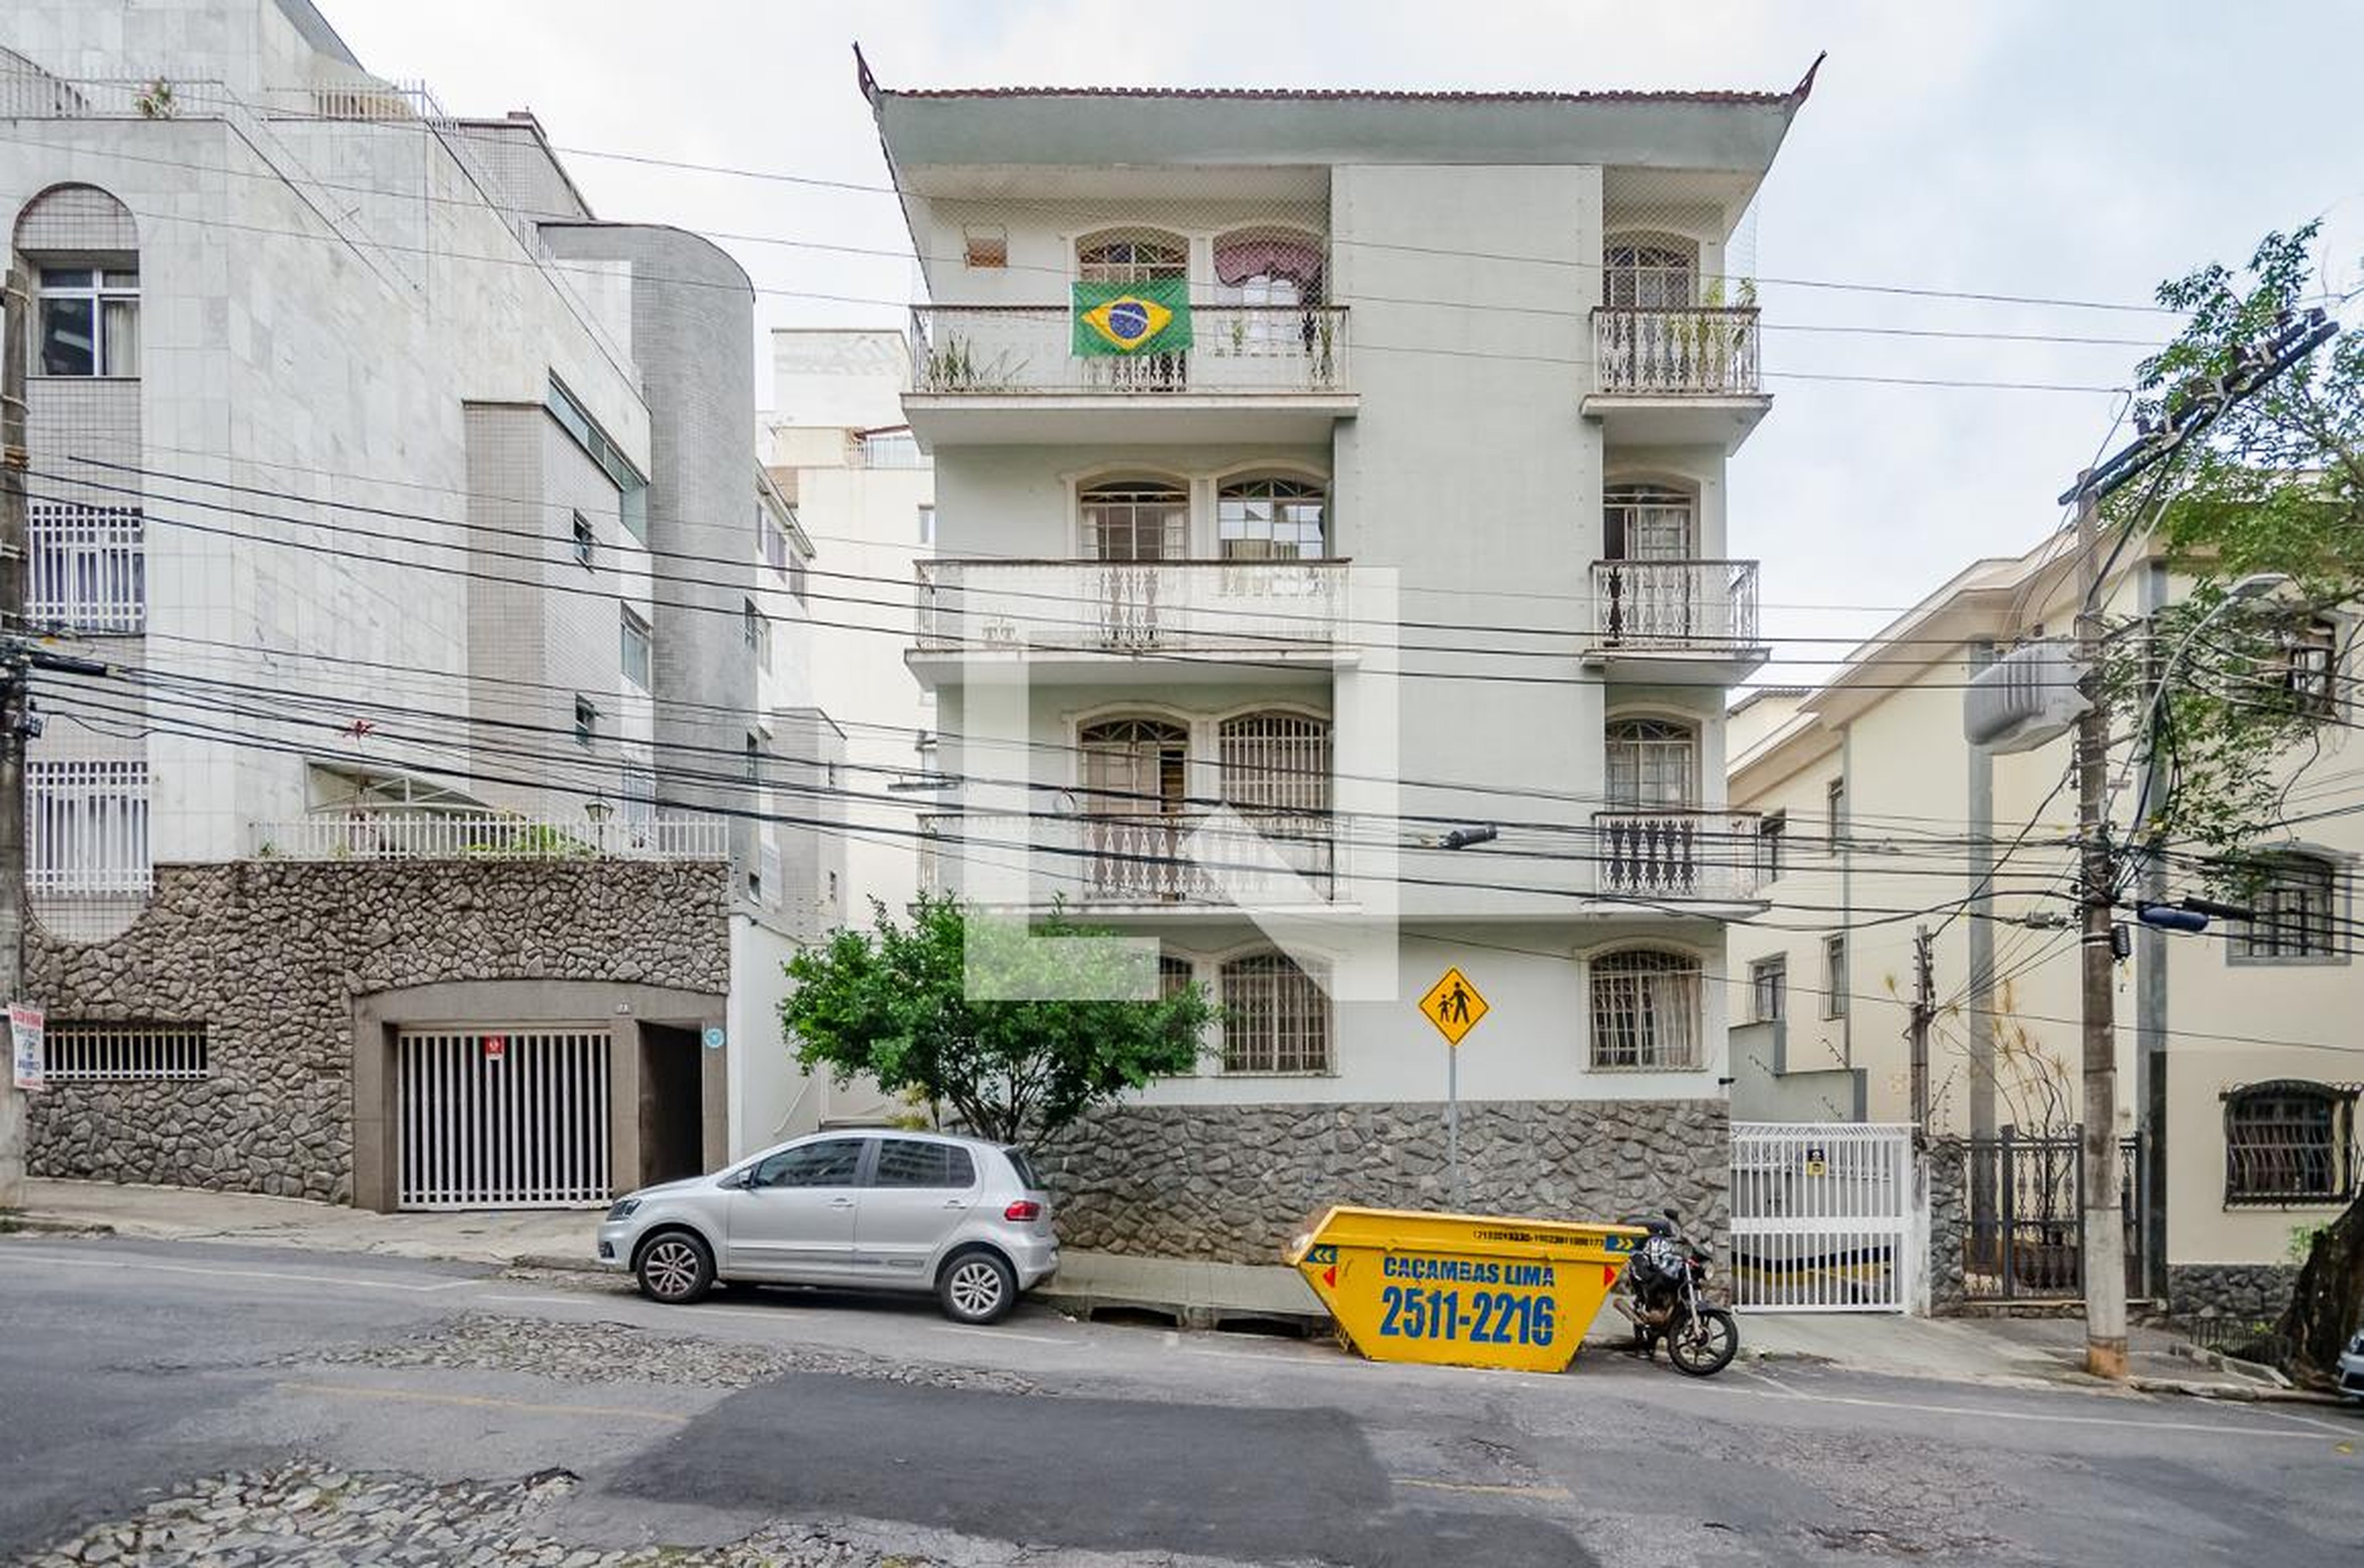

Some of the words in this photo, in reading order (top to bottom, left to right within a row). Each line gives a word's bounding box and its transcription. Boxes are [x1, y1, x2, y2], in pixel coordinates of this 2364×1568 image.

[1383, 1256, 1500, 1284] CAÇAMBAS
[1505, 1264, 1556, 1287] LIMA
[1380, 1285, 1556, 1346] 2511-2216
